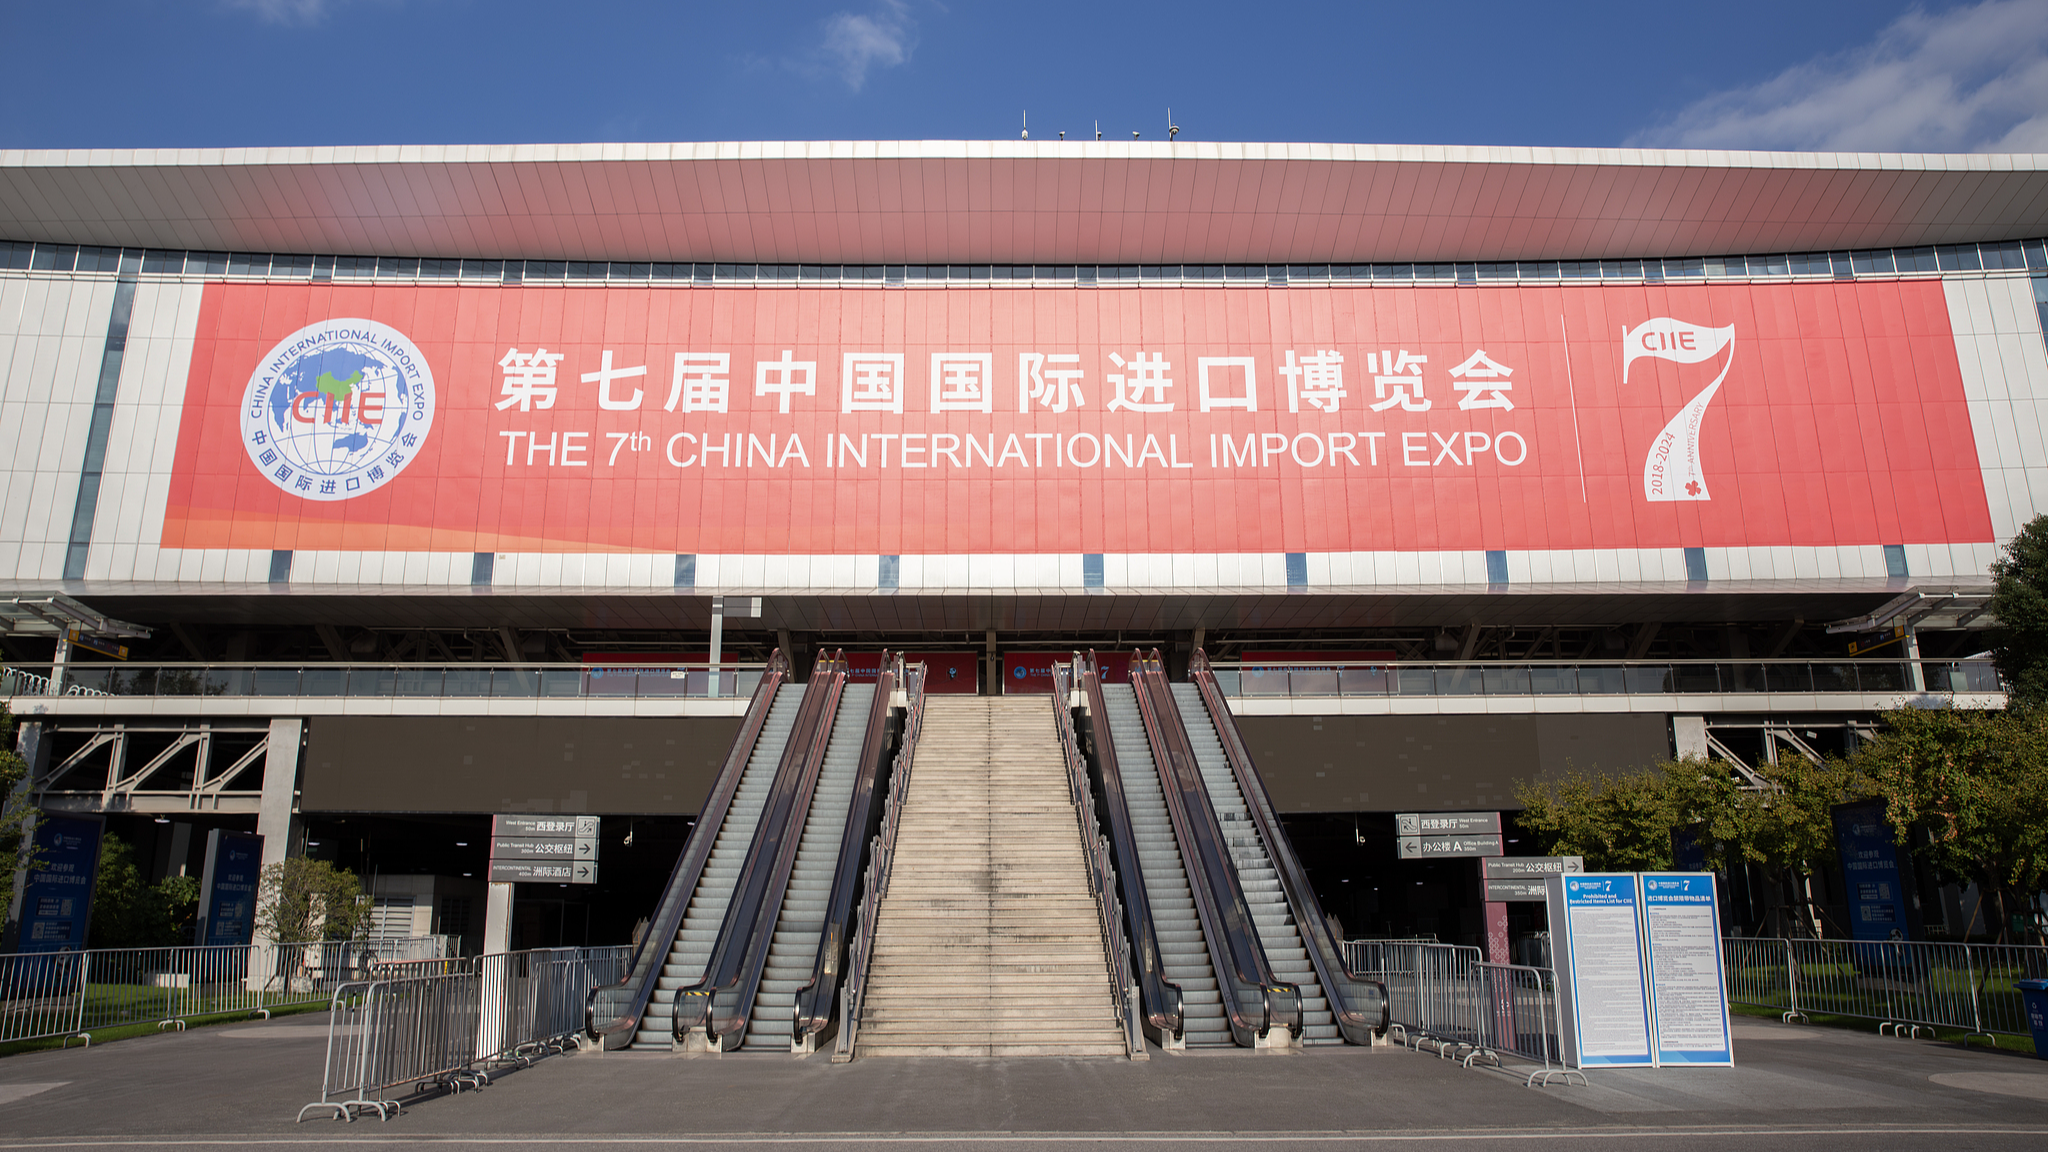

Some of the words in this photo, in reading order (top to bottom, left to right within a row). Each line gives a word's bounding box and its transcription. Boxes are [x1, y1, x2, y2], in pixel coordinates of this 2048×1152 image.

[1641, 331, 1697, 351] CIIE
[250, 376, 274, 419] CHINA
[269, 329, 378, 374] INTERNATIONAL
[380, 338, 421, 381] IMPORT
[412, 383, 426, 421] EXPO
[494, 347, 1516, 414] 第七届中国国际进口博览会
[292, 391, 387, 425] CIIE
[1687, 402, 1704, 464] ANNIVERSARY
[499, 430, 590, 467] THE
[604, 430, 652, 467] 7th
[665, 431, 811, 468] CHINA
[826, 431, 1194, 469] INTERNATIONAL
[1210, 431, 1386, 468] IMPORT
[1402, 430, 1529, 467] EXPO
[251, 429, 418, 495] 中国国际进口博览会
[1651, 431, 1676, 496] 2018-2024
[536, 821, 575, 832] 西登录厅
[1420, 818, 1458, 830] 西登录厅
[534, 843, 574, 855] 公交枢纽
[1422, 841, 1451, 853] 办公楼
[1452, 841, 1463, 852] A
[1857, 849, 1880, 859] 欢迎参观
[50, 862, 75, 873] 欢迎参观
[532, 865, 573, 877] 洲际酒店
[1525, 862, 1563, 873] 公交枢纽
[1846, 859, 1895, 871] 中国国际进口博览会
[33, 873, 87, 886] 中国国际进口博览会
